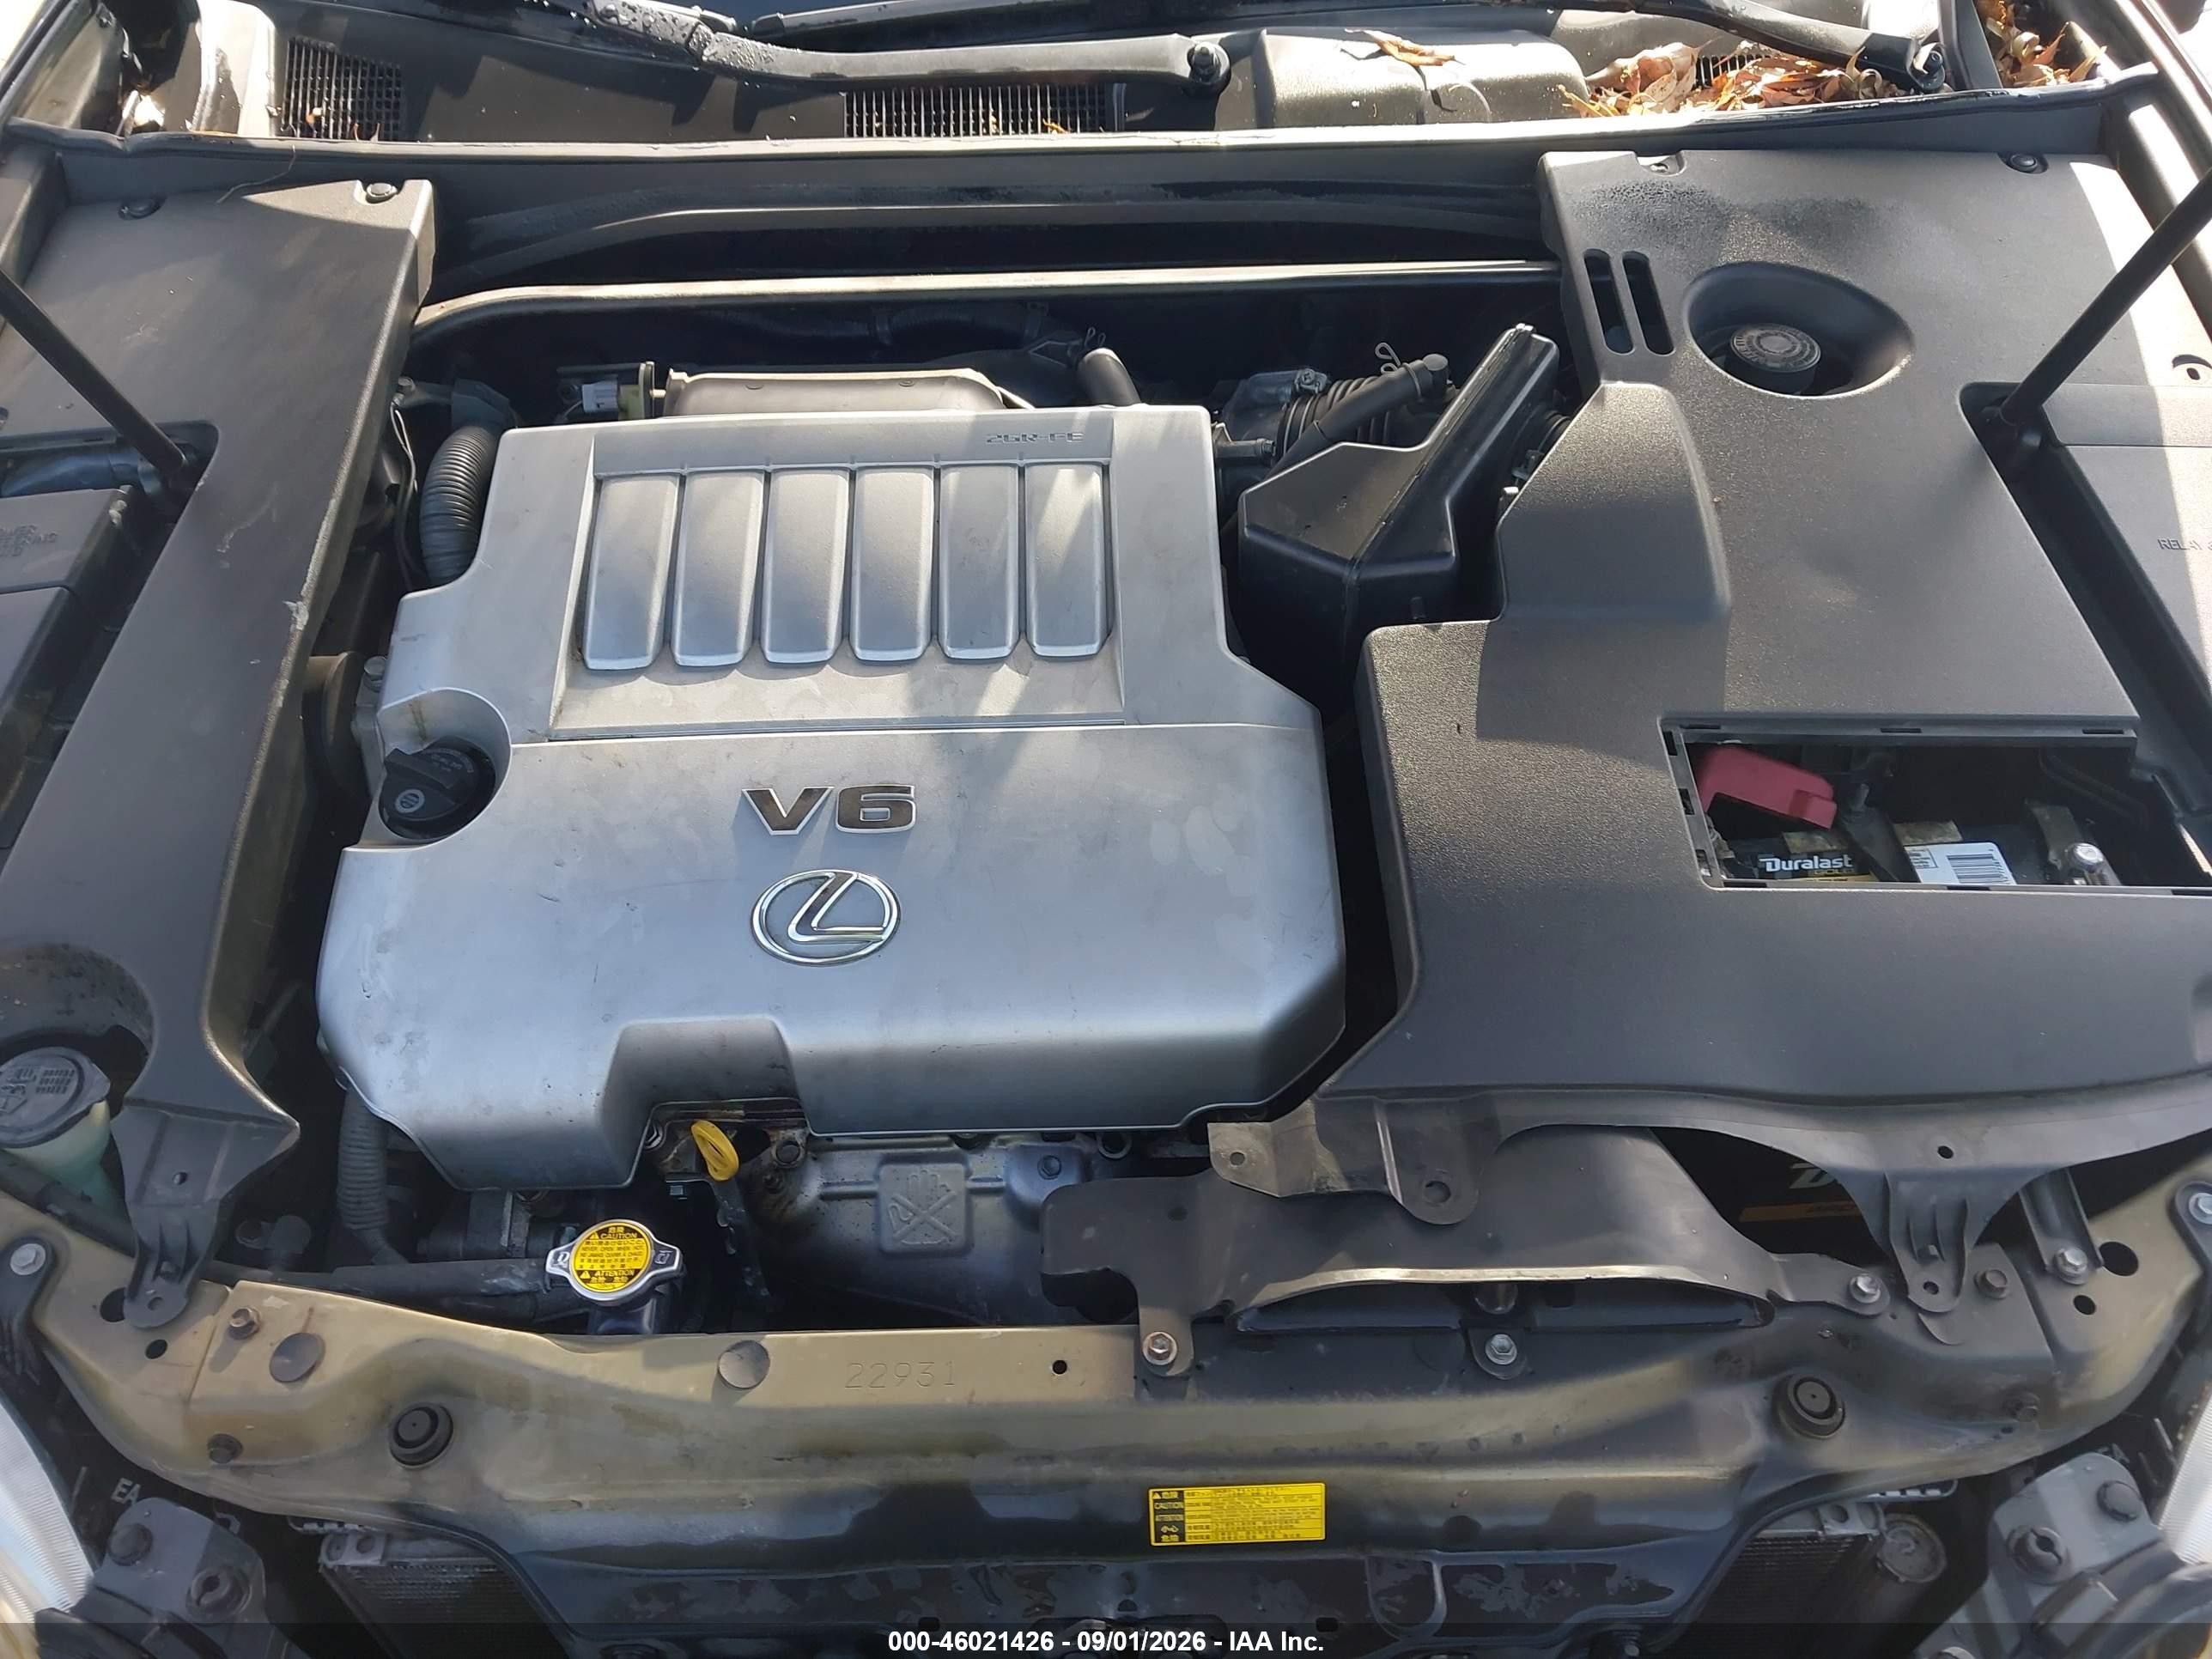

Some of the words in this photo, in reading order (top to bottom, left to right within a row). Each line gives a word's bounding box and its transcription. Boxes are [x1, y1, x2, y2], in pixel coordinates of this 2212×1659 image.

[741, 784, 917, 835] V6
[1759, 854, 1853, 872] Duralast
[844, 1361, 955, 1389] 22931
